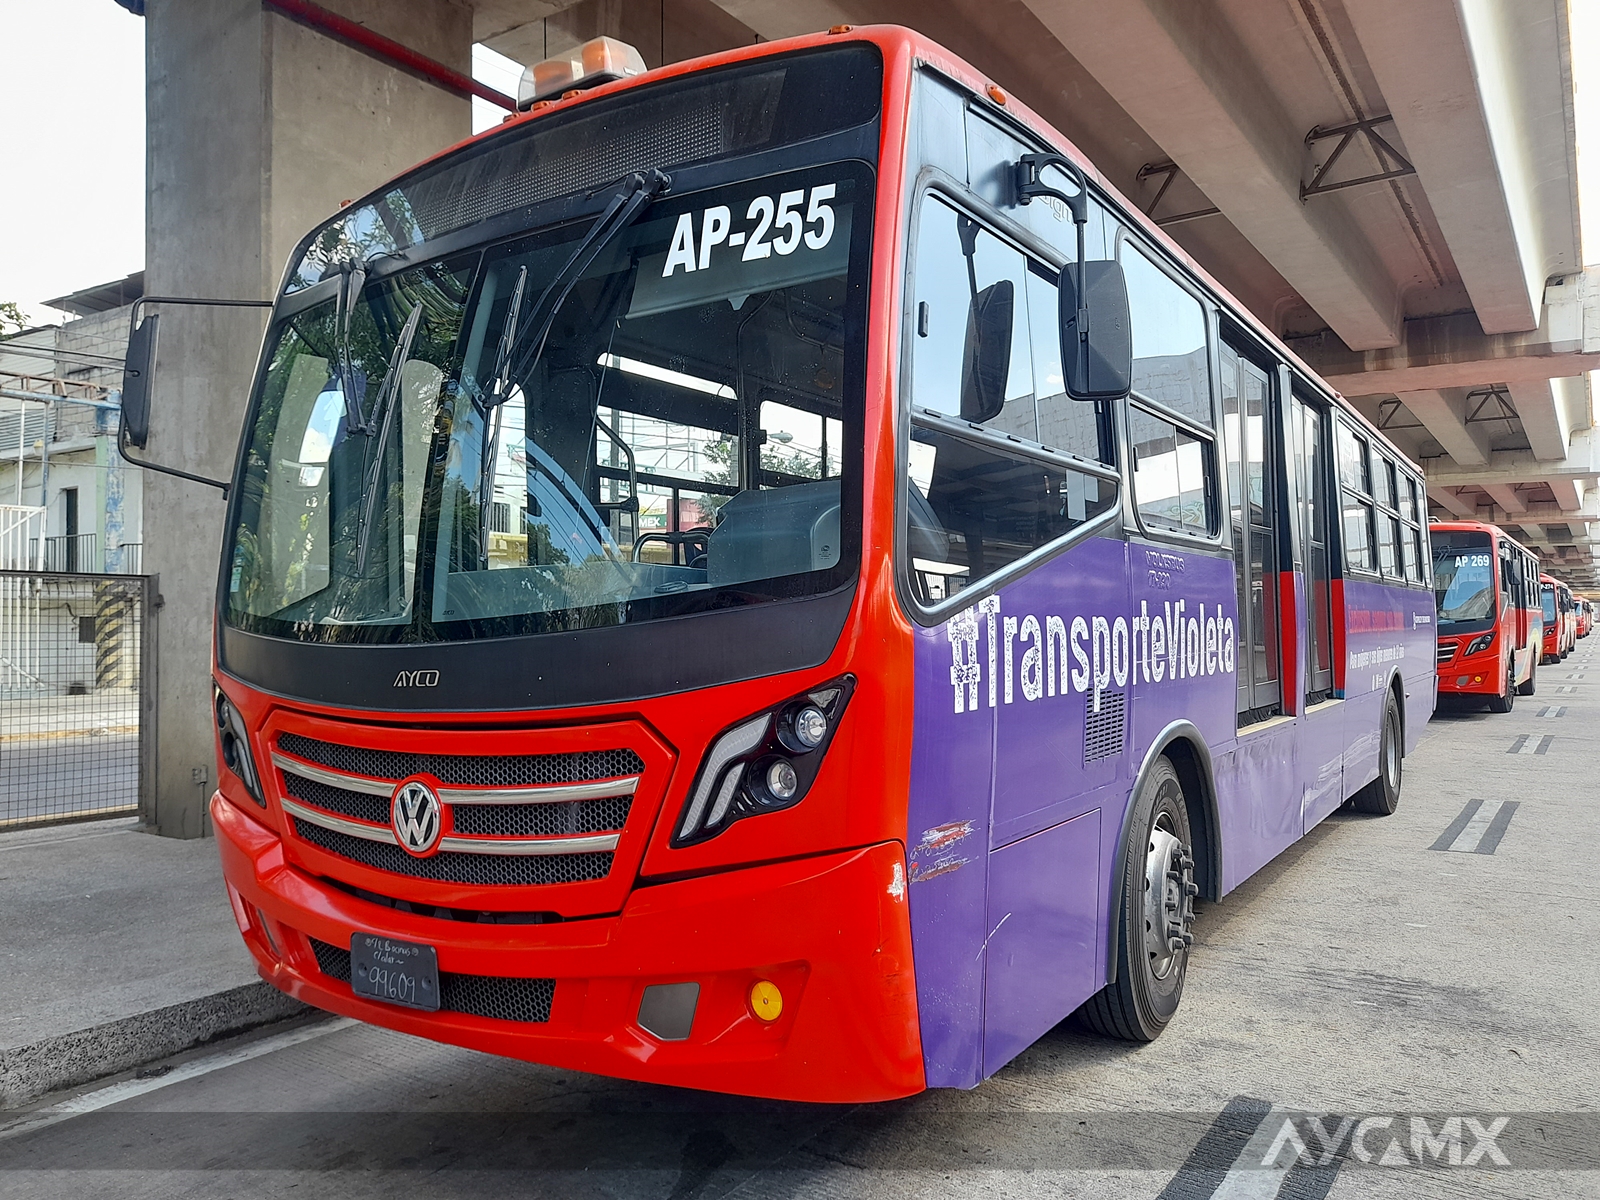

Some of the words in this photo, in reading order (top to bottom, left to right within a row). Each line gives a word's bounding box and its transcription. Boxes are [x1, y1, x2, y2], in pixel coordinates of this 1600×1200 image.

[662, 183, 837, 278] AP-255
[1455, 556, 1468, 568] AP
[1471, 555, 1489, 567] 269
[947, 595, 1234, 713] #TransporteVioleta
[393, 669, 440, 687] AYCO
[369, 966, 415, 1003] 99609
